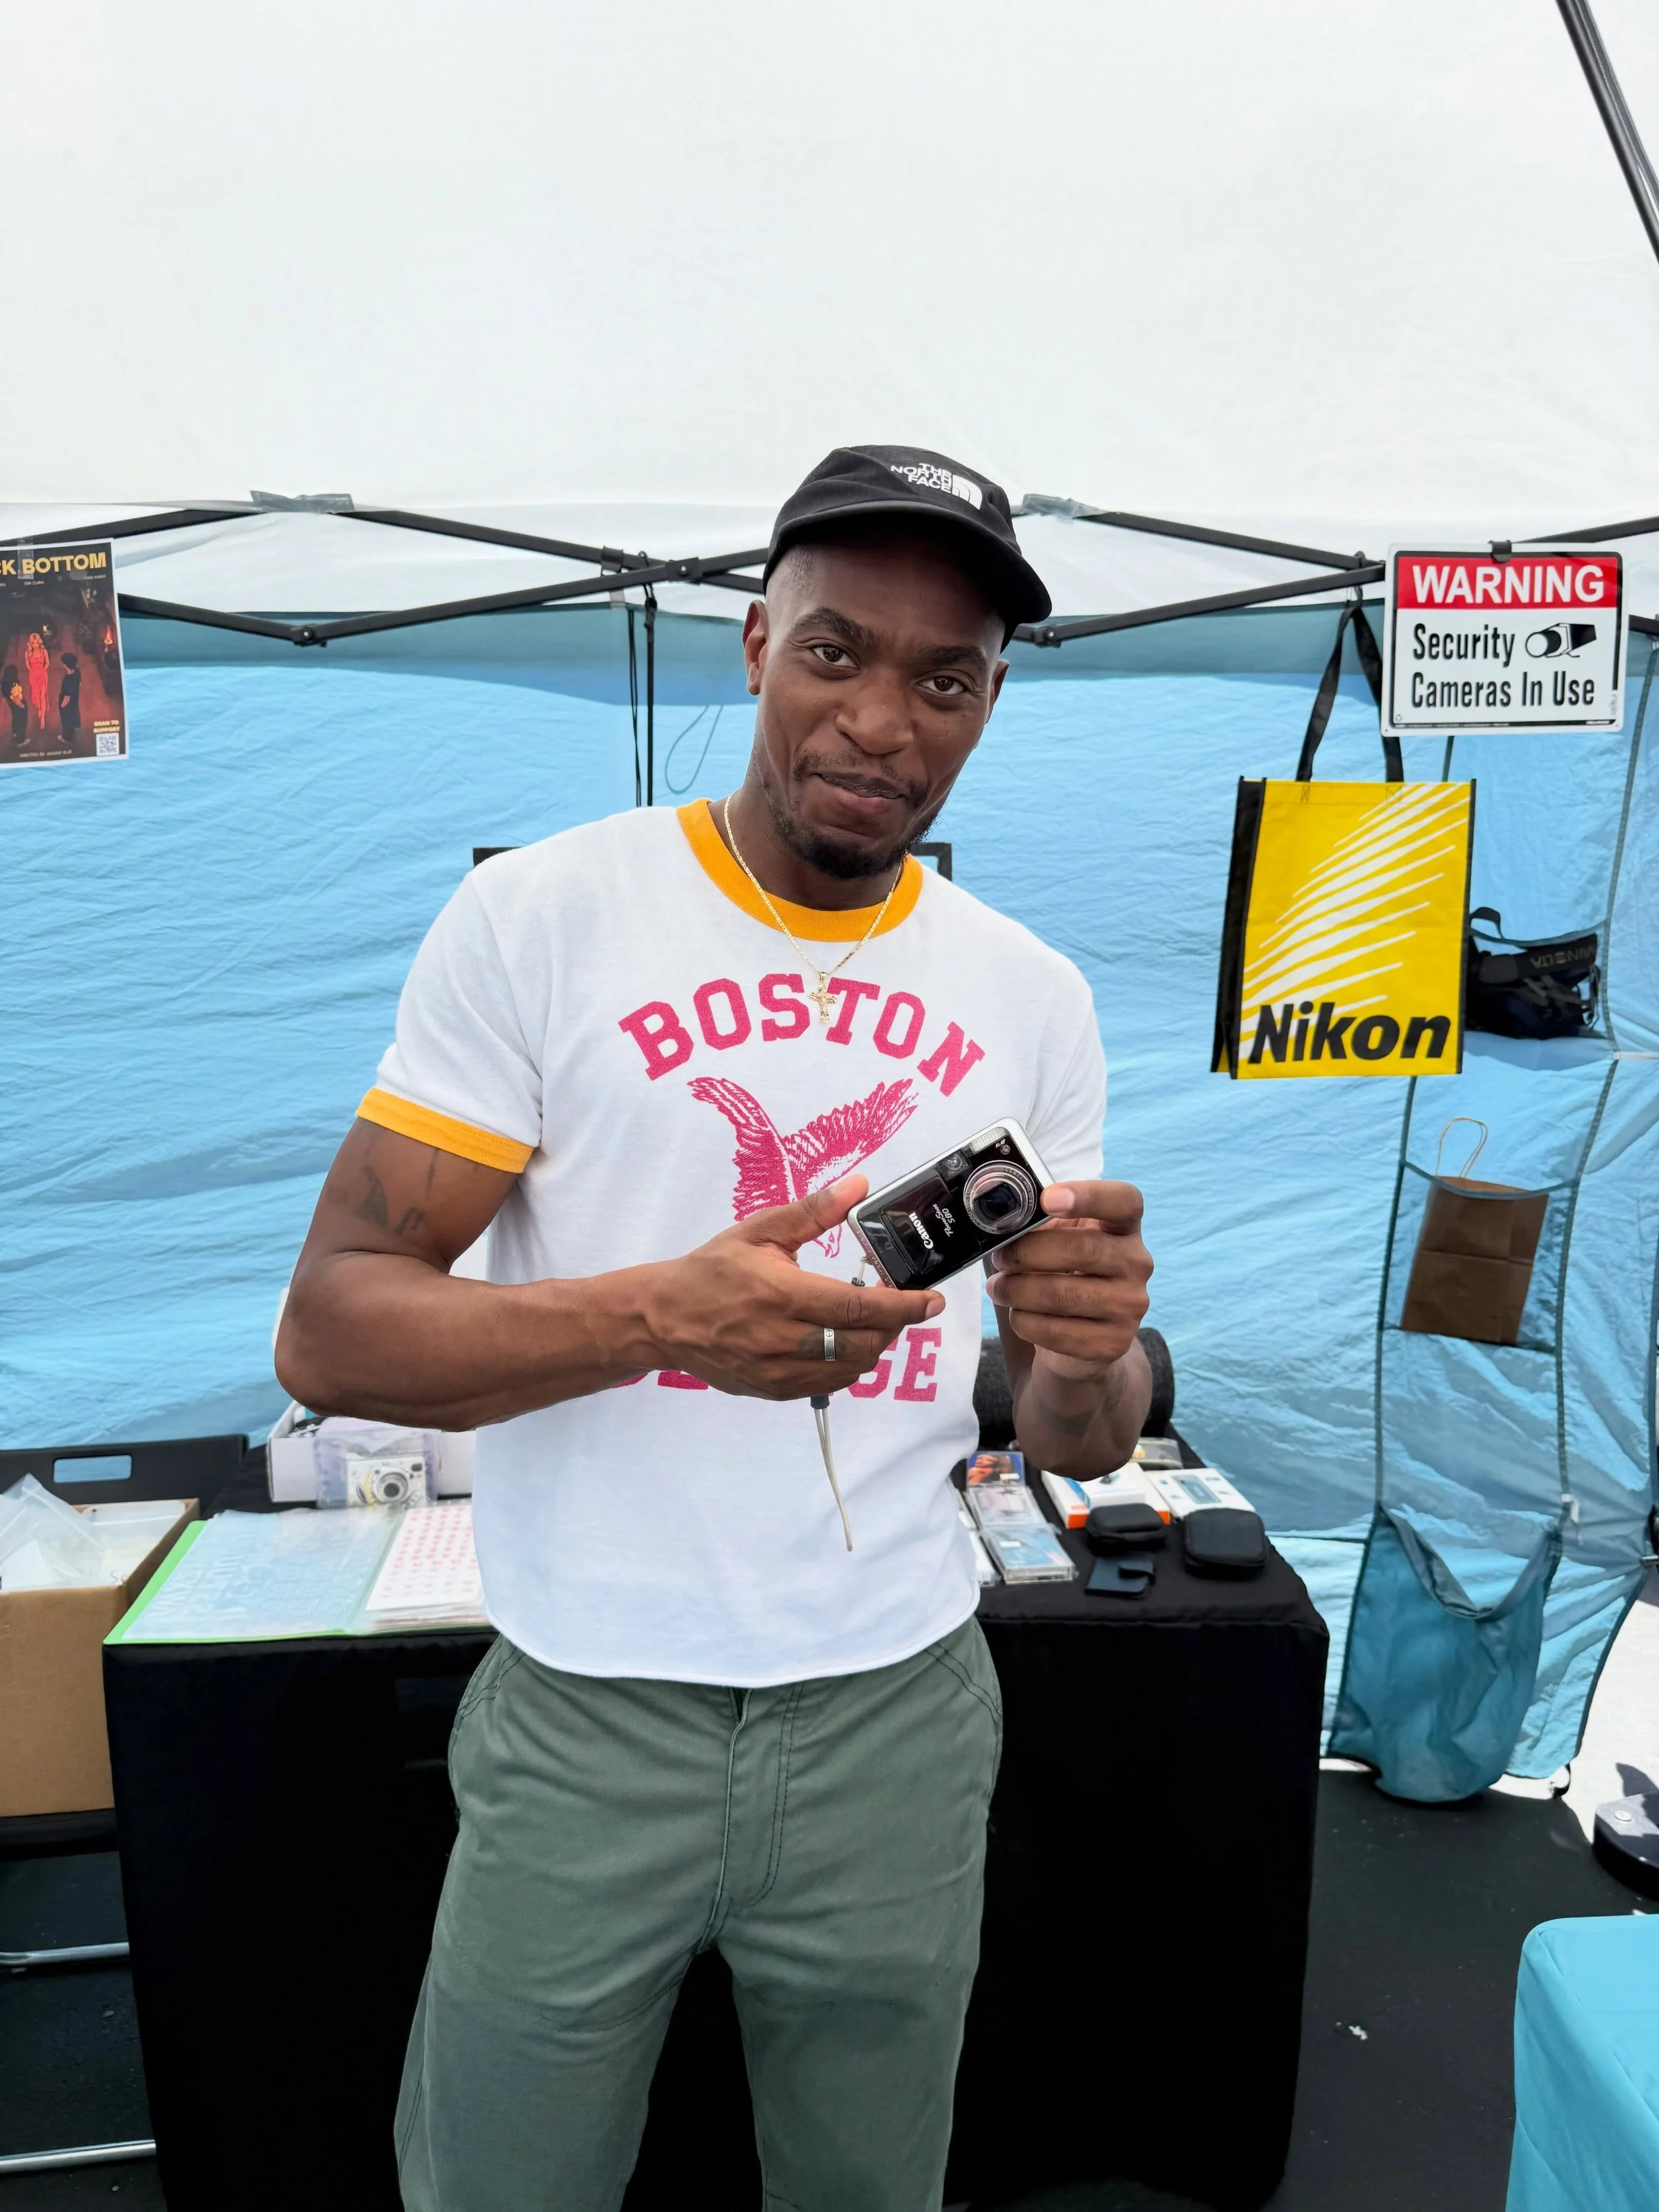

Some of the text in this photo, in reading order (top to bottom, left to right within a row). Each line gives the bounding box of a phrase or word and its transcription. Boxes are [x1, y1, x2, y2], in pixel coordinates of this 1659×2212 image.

[891, 465, 952, 486] NORTH
[908, 475, 952, 493] FACE
[918, 463, 952, 477] THE
[0, 553, 107, 575] K BOTTOM
[1413, 565, 1604, 603] WARNING
[1413, 623, 1515, 668] Security
[1412, 672, 1510, 708] Cameras
[1522, 672, 1542, 706] In
[1553, 671, 1594, 705] Use
[618, 973, 985, 1097] BOSTON
[1248, 1001, 1451, 1064] Nikon
[908, 1213, 934, 1250] Canon
[932, 1203, 954, 1237] PowerShot
[942, 1208, 956, 1224] S80
